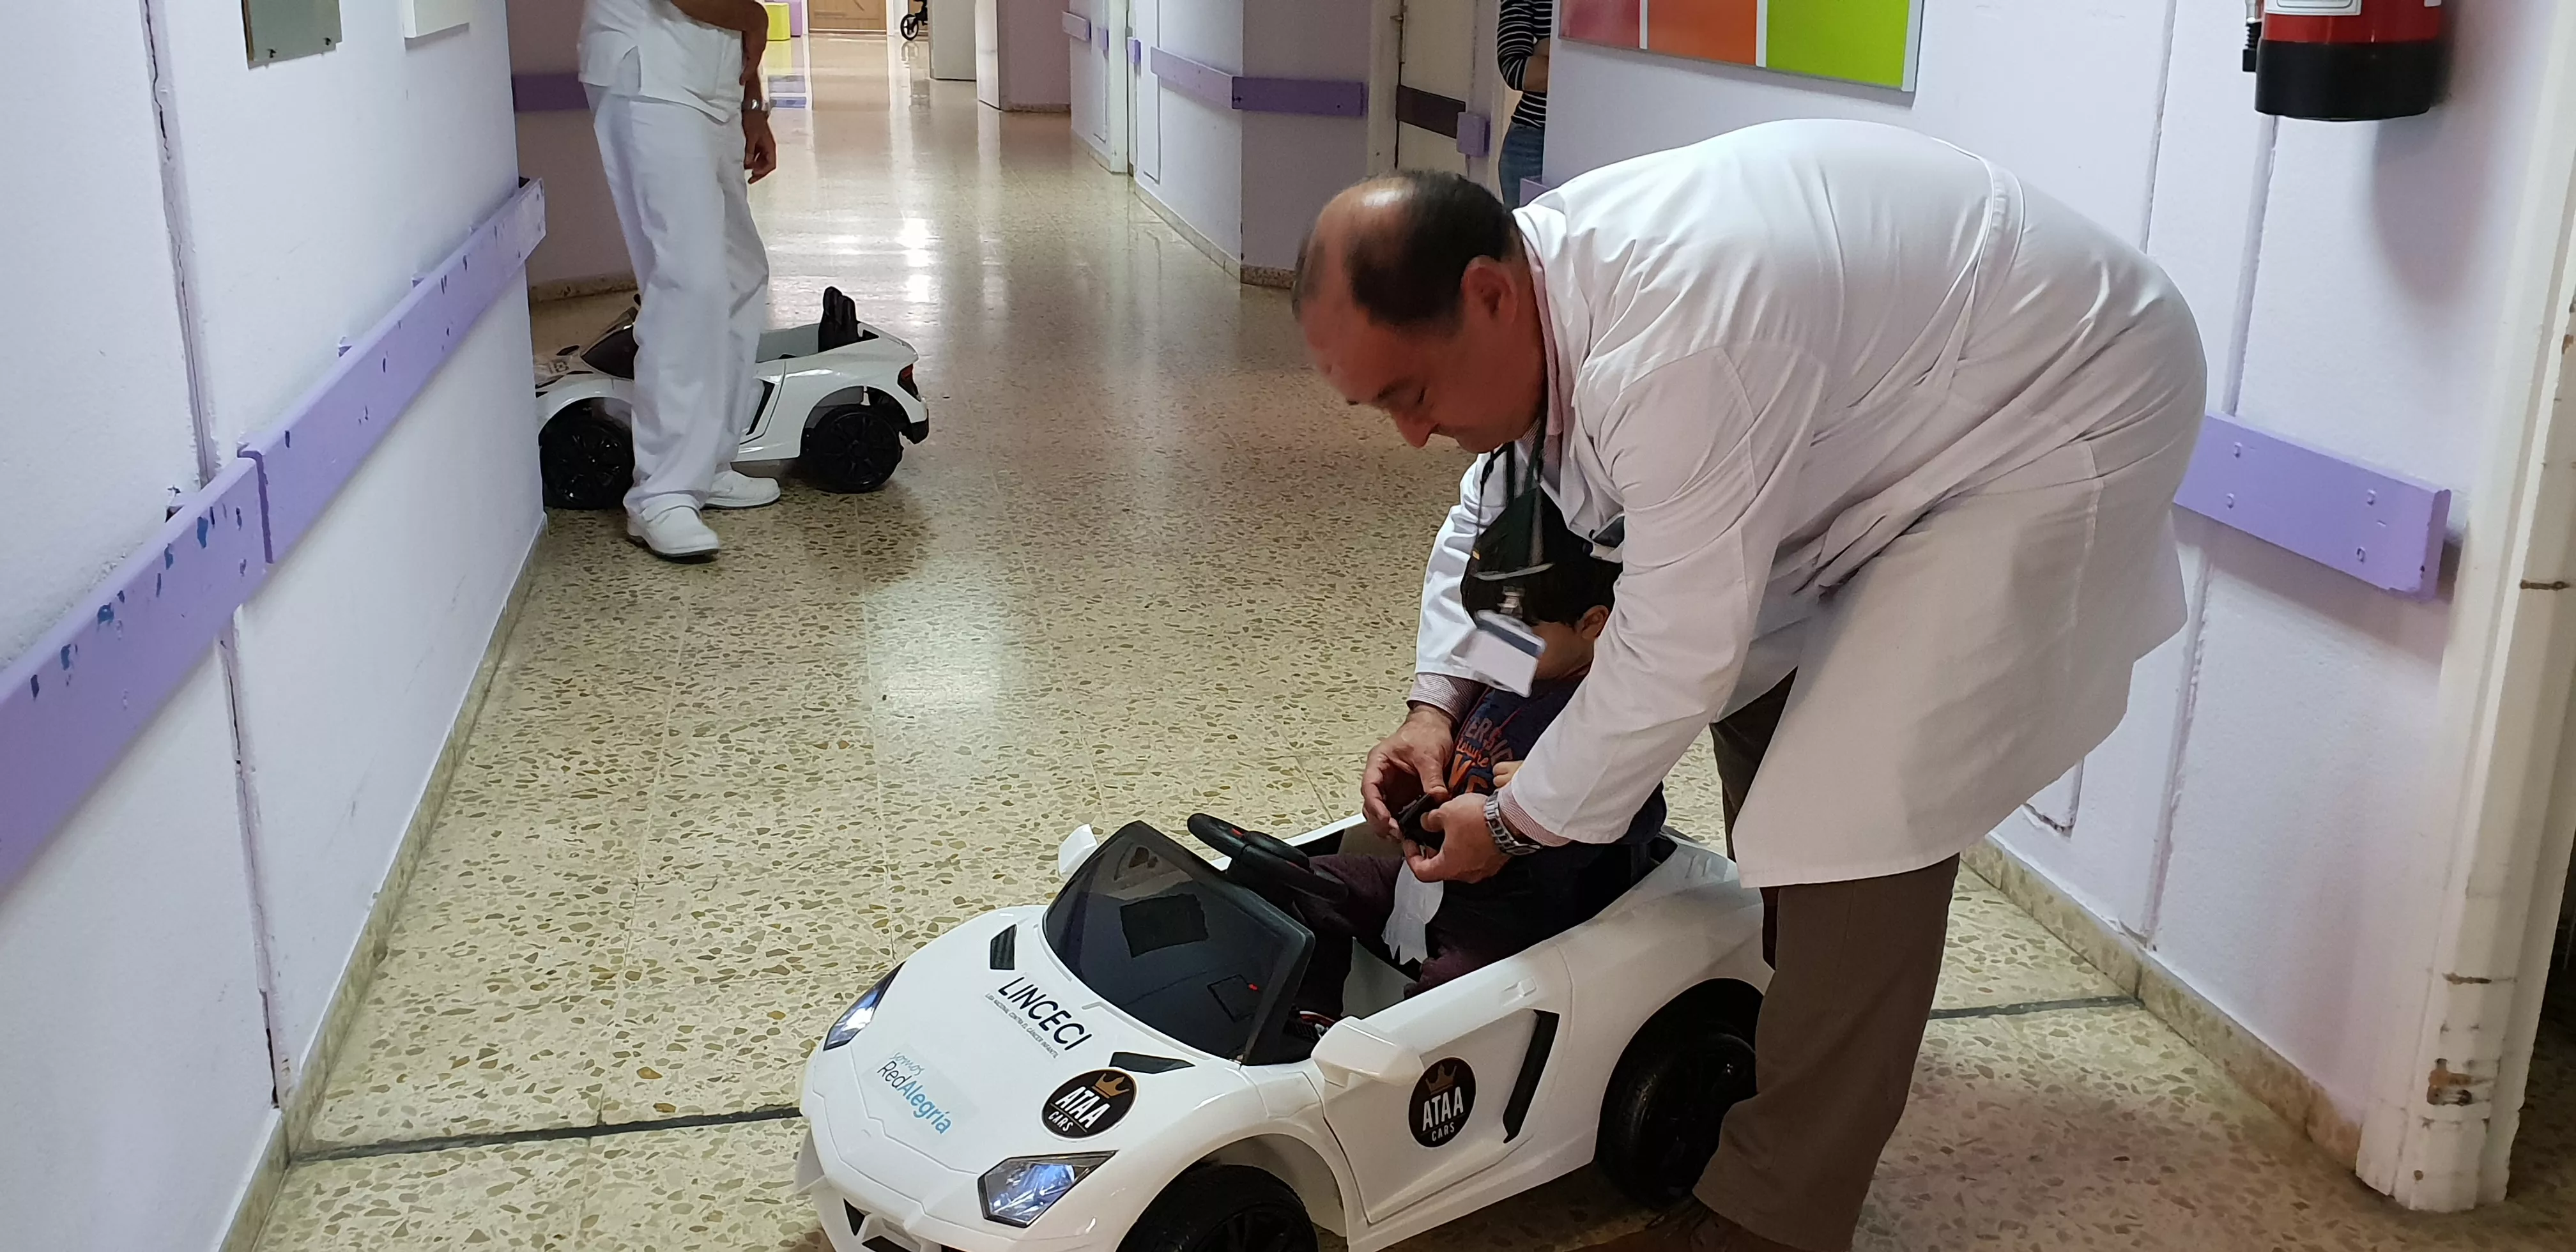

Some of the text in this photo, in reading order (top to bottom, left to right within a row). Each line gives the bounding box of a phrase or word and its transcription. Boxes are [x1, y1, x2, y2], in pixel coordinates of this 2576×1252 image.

[998, 977, 1092, 1051] LINCECI
[889, 1051, 925, 1076] somos
[877, 1060, 952, 1134] RedAlegría
[1054, 1086, 1111, 1129] ATAA
[1422, 1086, 1464, 1132] ATAA
[1048, 1110, 1074, 1133] CARS
[1431, 1121, 1455, 1142] CARS
